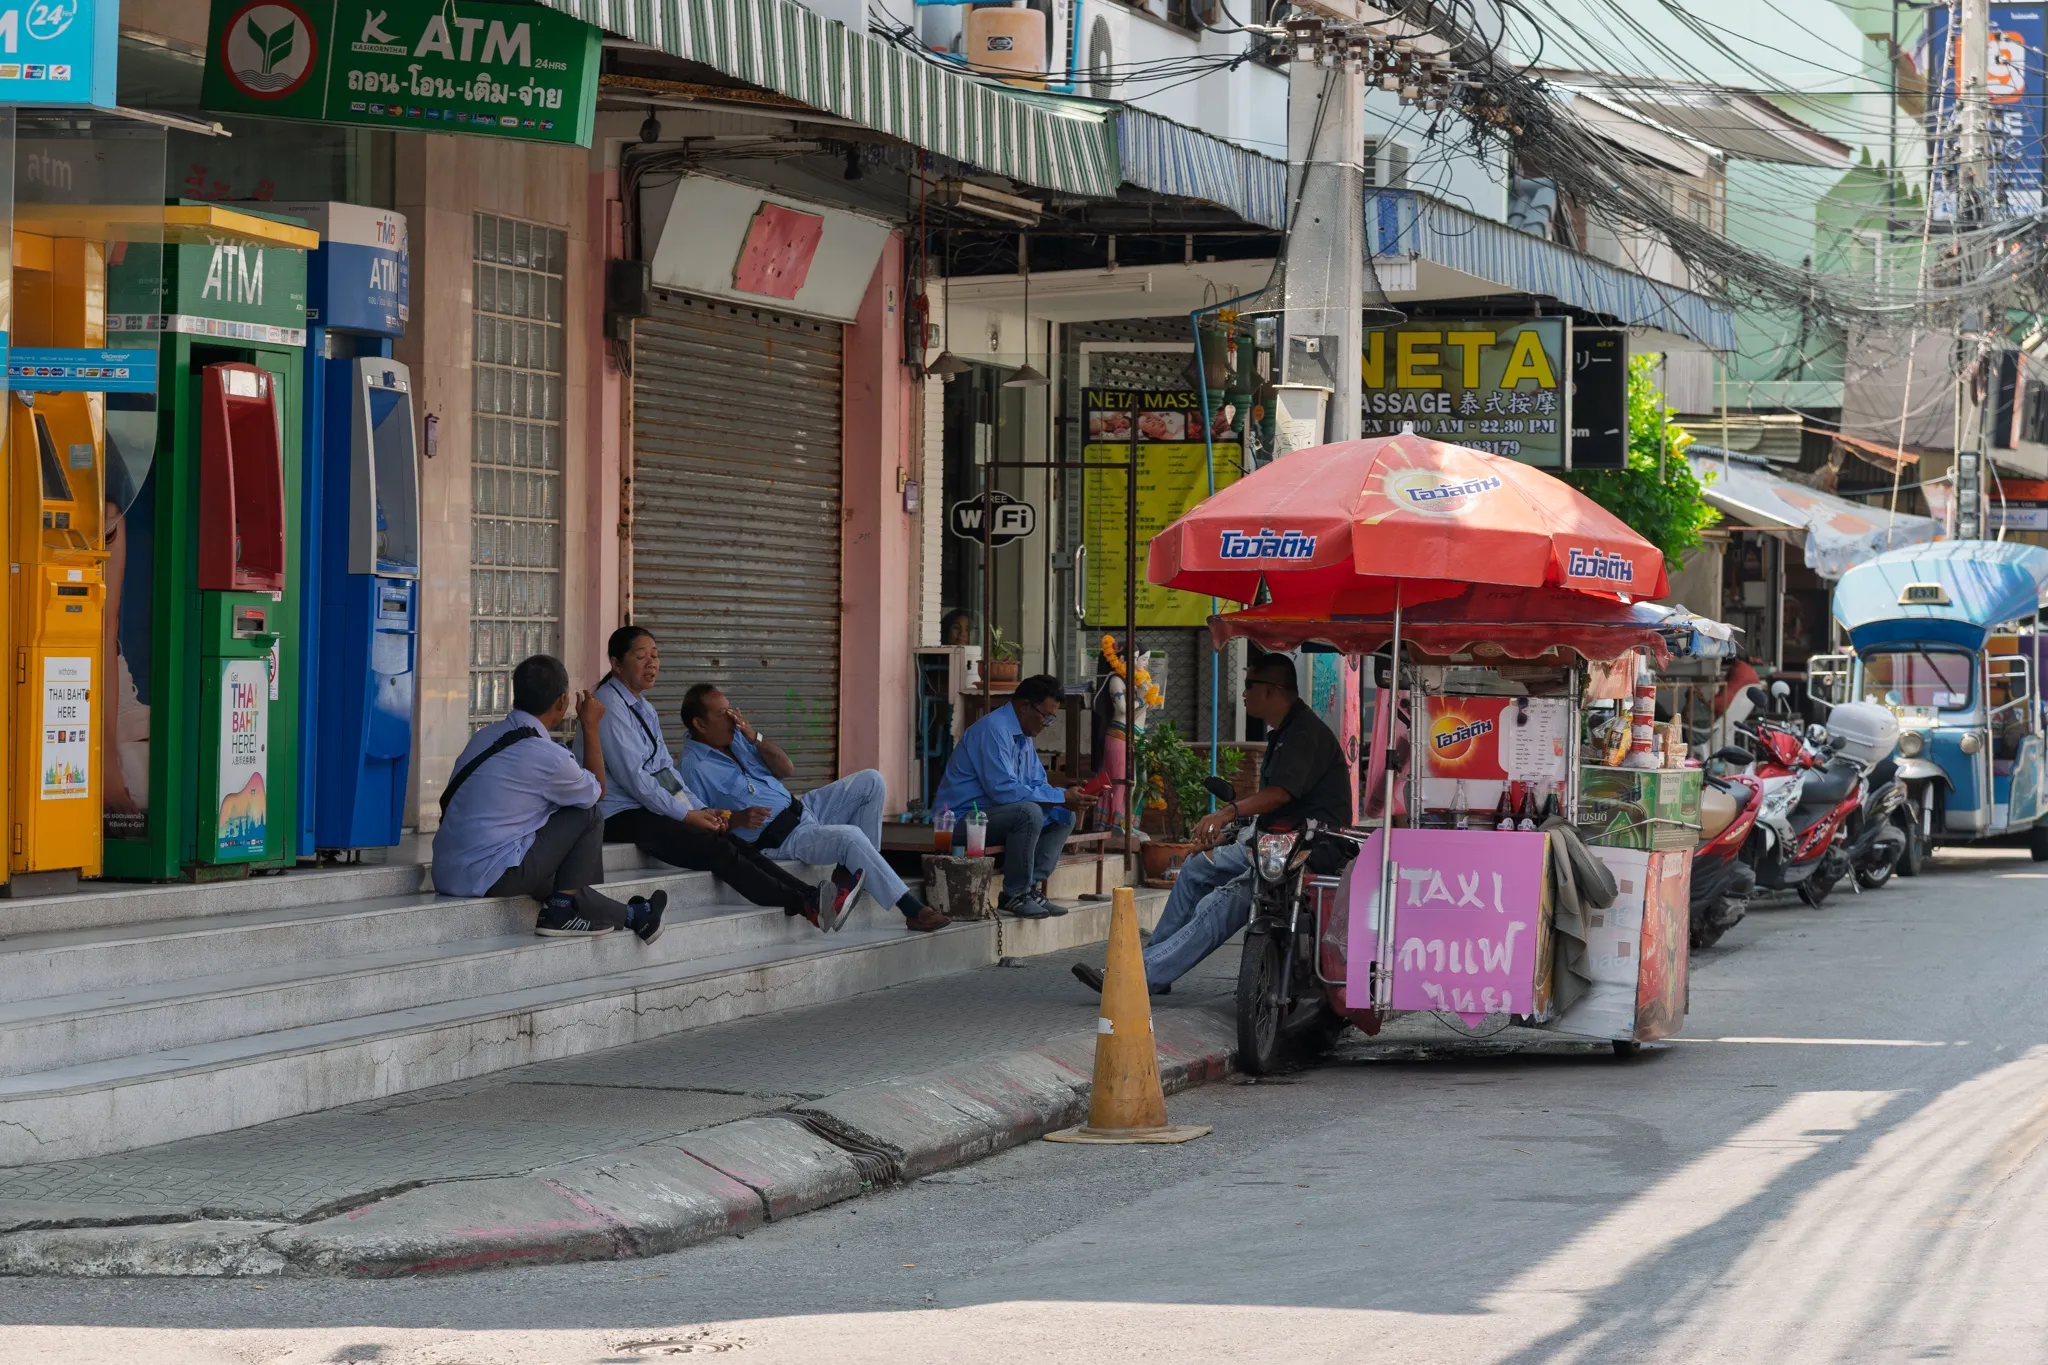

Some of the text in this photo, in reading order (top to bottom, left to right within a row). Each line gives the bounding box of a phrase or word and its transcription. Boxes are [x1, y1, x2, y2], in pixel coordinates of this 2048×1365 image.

[32, 4, 64, 25] 24
[352, 43, 406, 54] KASIKORNTHAI
[413, 14, 531, 68] ATM
[535, 58, 568, 71] 24HRS
[348, 63, 563, 109] ถอน-โอน-เติม-จ่าย
[28, 149, 72, 191] atm
[376, 219, 396, 246] TMB
[201, 244, 264, 306] ATM
[369, 257, 398, 293] ATM
[1362, 390, 1557, 415] ASSAGE 泰式按摩
[1389, 419, 1431, 433] 1000
[1435, 420, 1464, 433] AM
[1480, 419, 1524, 433] 22.30
[1528, 420, 1556, 433] PM
[1405, 475, 1501, 502] โอวัลติน
[1220, 528, 1318, 559] โอวัลติน
[1568, 547, 1633, 582] โอวัลติน
[49, 688, 86, 700] THAI BAHT
[231, 683, 258, 709] THAI
[57, 706, 77, 718] HERE
[232, 711, 259, 733] BAHT
[231, 734, 257, 754] HERE!
[1435, 718, 1494, 749] โอวัลติน
[1399, 867, 1504, 913] TAXI
[1398, 920, 1527, 976] กาแฟ
